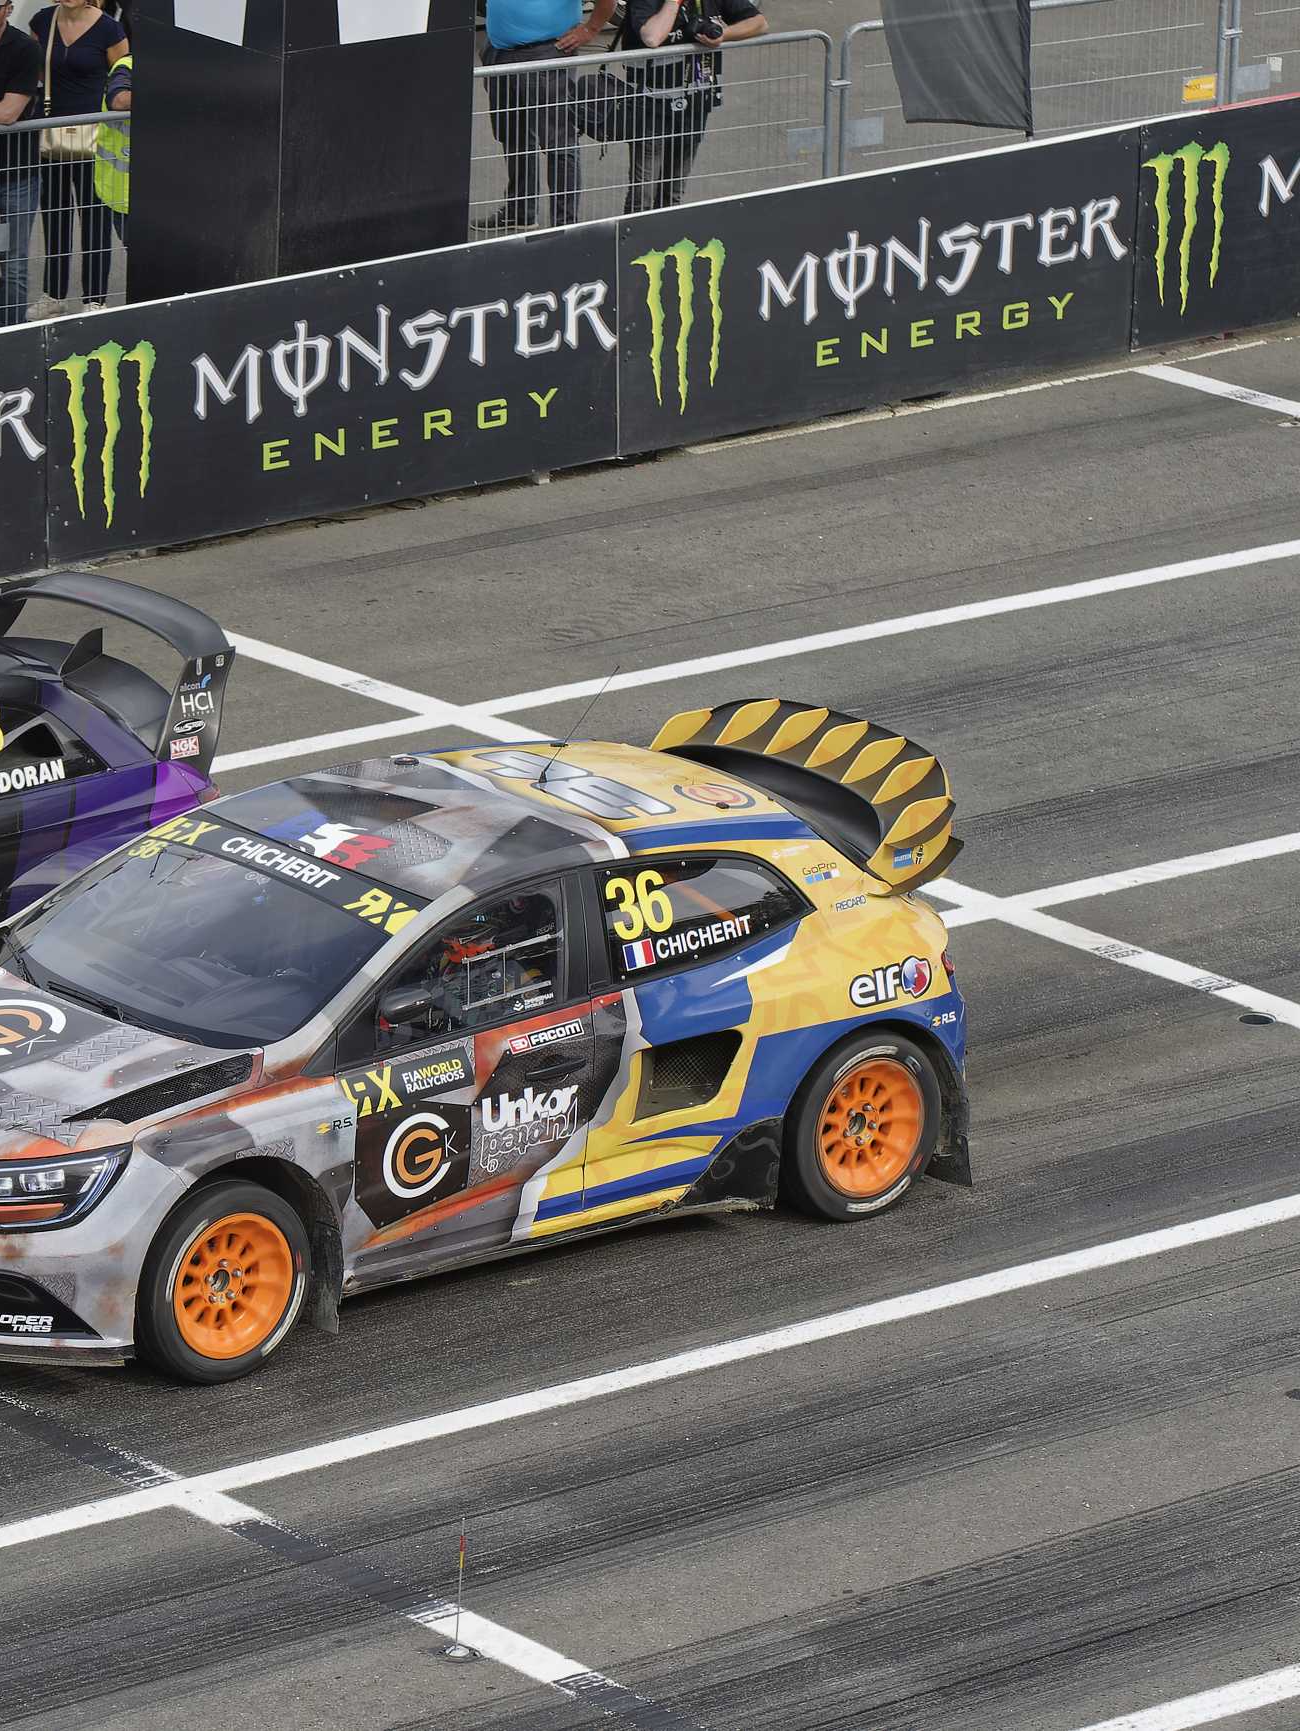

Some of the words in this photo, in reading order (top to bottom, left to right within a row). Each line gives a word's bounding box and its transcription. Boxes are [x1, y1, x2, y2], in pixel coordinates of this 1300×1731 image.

[757, 194, 1129, 326] MONSTER
[190, 278, 618, 424] MONSTER
[815, 291, 1075, 368] ENERGY
[262, 387, 560, 472] ENERGY
[181, 691, 214, 714] HCI
[170, 735, 199, 754] NGK
[220, 834, 343, 890] CHICHERIT
[801, 860, 838, 876] GoPro
[605, 869, 674, 941] 36
[835, 894, 867, 912] RECARO
[655, 914, 752, 960] CHICHERIT
[849, 962, 901, 1008] elf
[529, 1022, 582, 1046] FACOM
[405, 1069, 465, 1094] RALLYCROSS
[10, 1322, 53, 1333] TIRES
